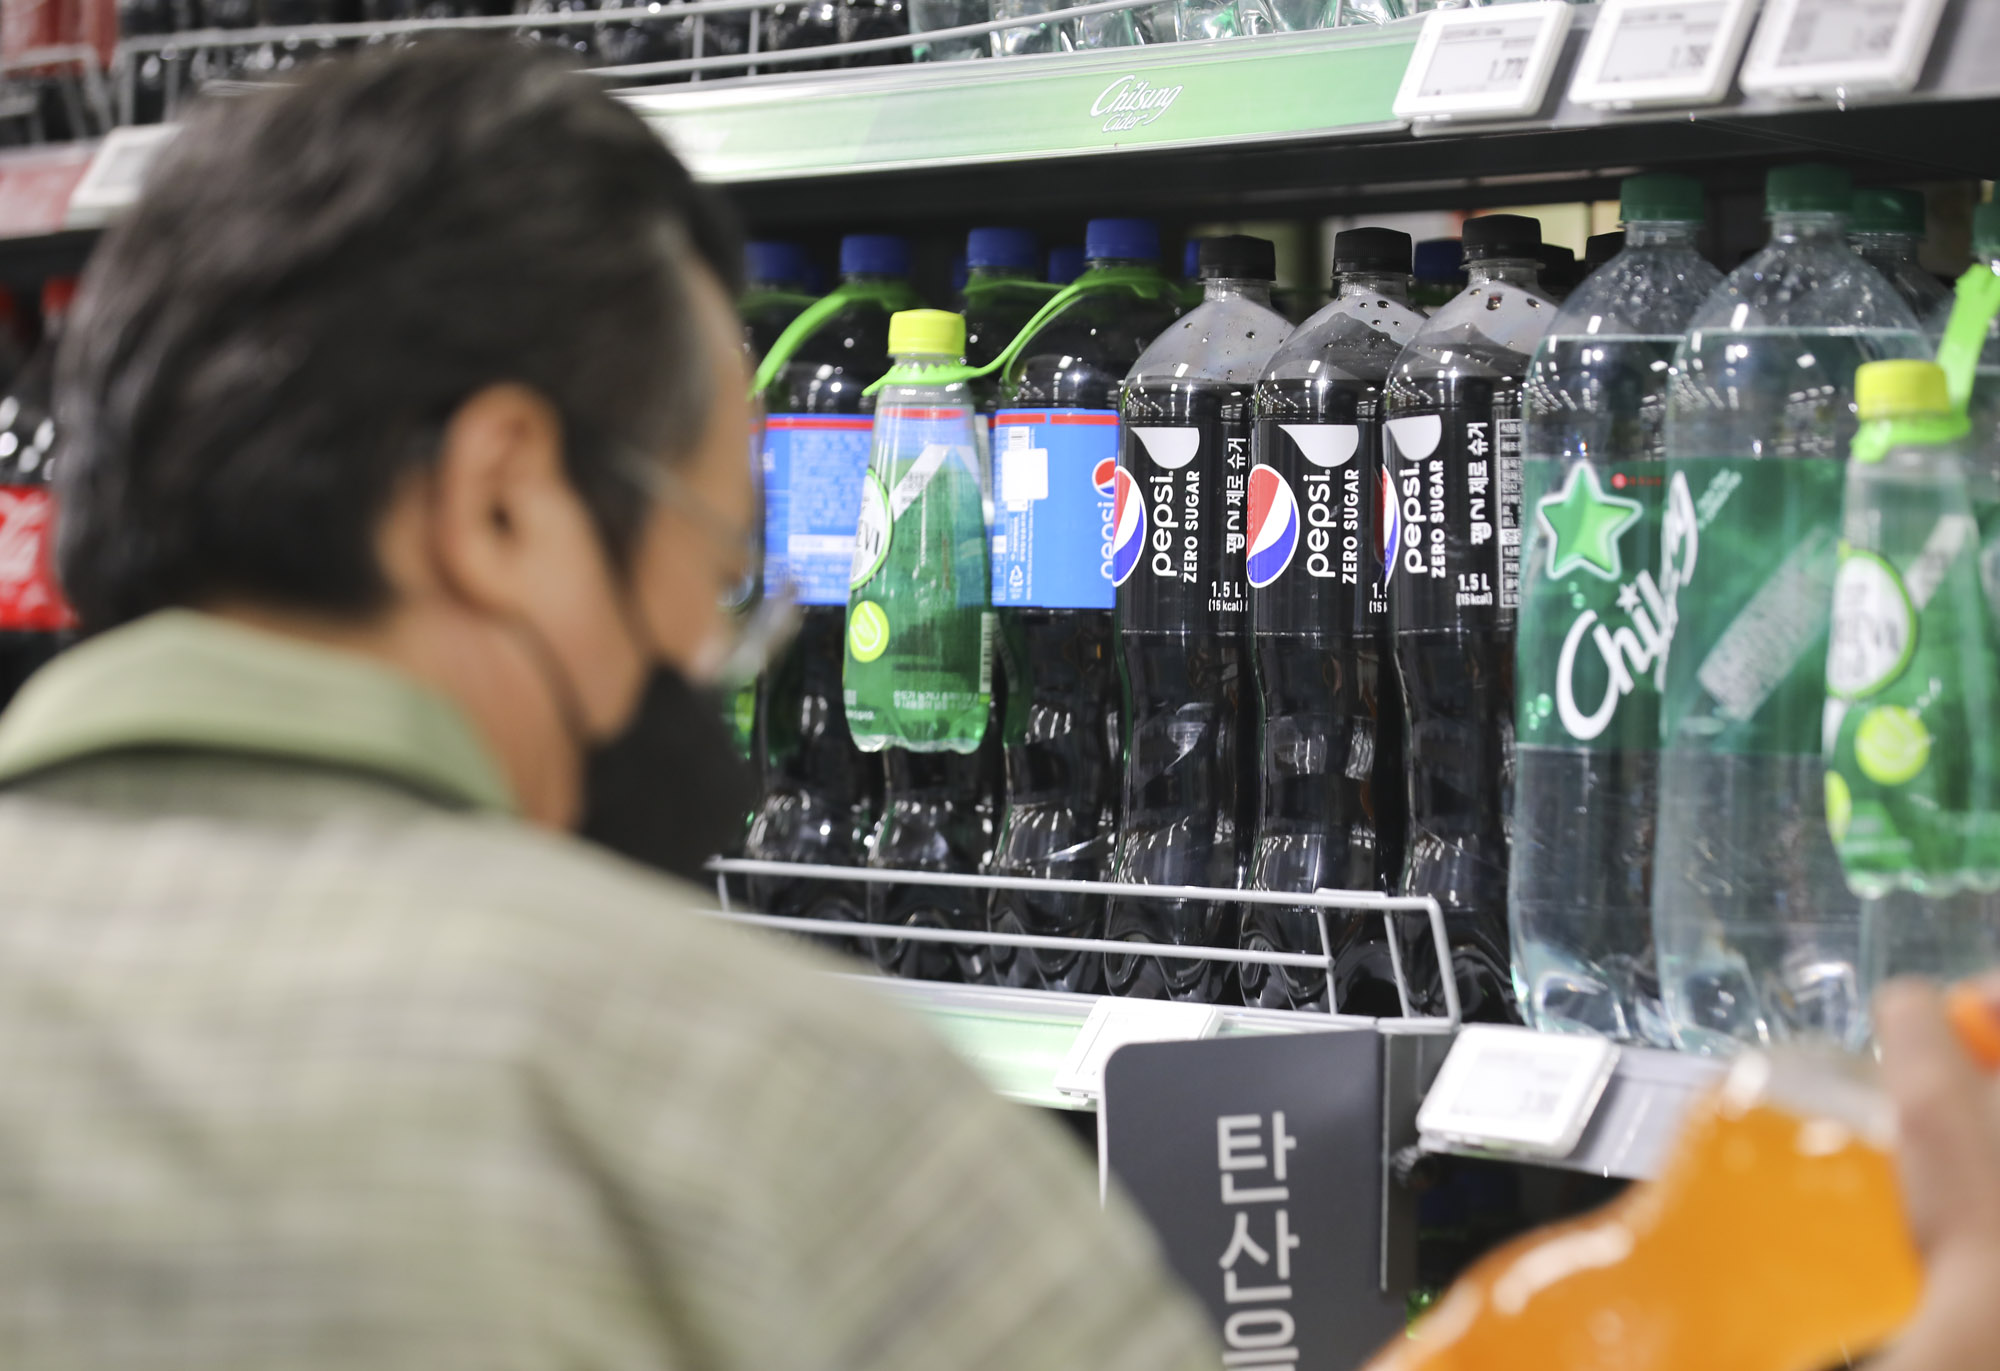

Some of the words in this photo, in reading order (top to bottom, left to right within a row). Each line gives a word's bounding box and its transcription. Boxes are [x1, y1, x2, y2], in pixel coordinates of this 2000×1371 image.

[1090, 74, 1184, 126] Chilsung
[1102, 112, 1150, 133] Cider
[1227, 438, 1247, 470] 슈거
[1466, 422, 1489, 456] 슈거
[1226, 474, 1246, 507] 제로
[1343, 469, 1360, 530] SUGAR
[1429, 460, 1445, 523] SUGAR
[1467, 460, 1489, 495] 제로
[1185, 470, 1200, 531] SUGAR
[1399, 466, 1428, 575] pepsi
[1151, 473, 1179, 577] pepsi
[1226, 510, 1246, 554] 펩시
[1306, 472, 1337, 578] pepsi
[1183, 536, 1198, 583] ZERO
[1342, 536, 1358, 584] ZERO
[1430, 528, 1446, 578] ZERO
[1208, 599, 1221, 612] (15
[1222, 599, 1243, 612] kcal)
[1211, 581, 1231, 598] 1.5
[1234, 581, 1242, 598] L
[1372, 582, 1387, 599] 1.
[1458, 574, 1479, 593] 1.5
[1481, 573, 1491, 592] L
